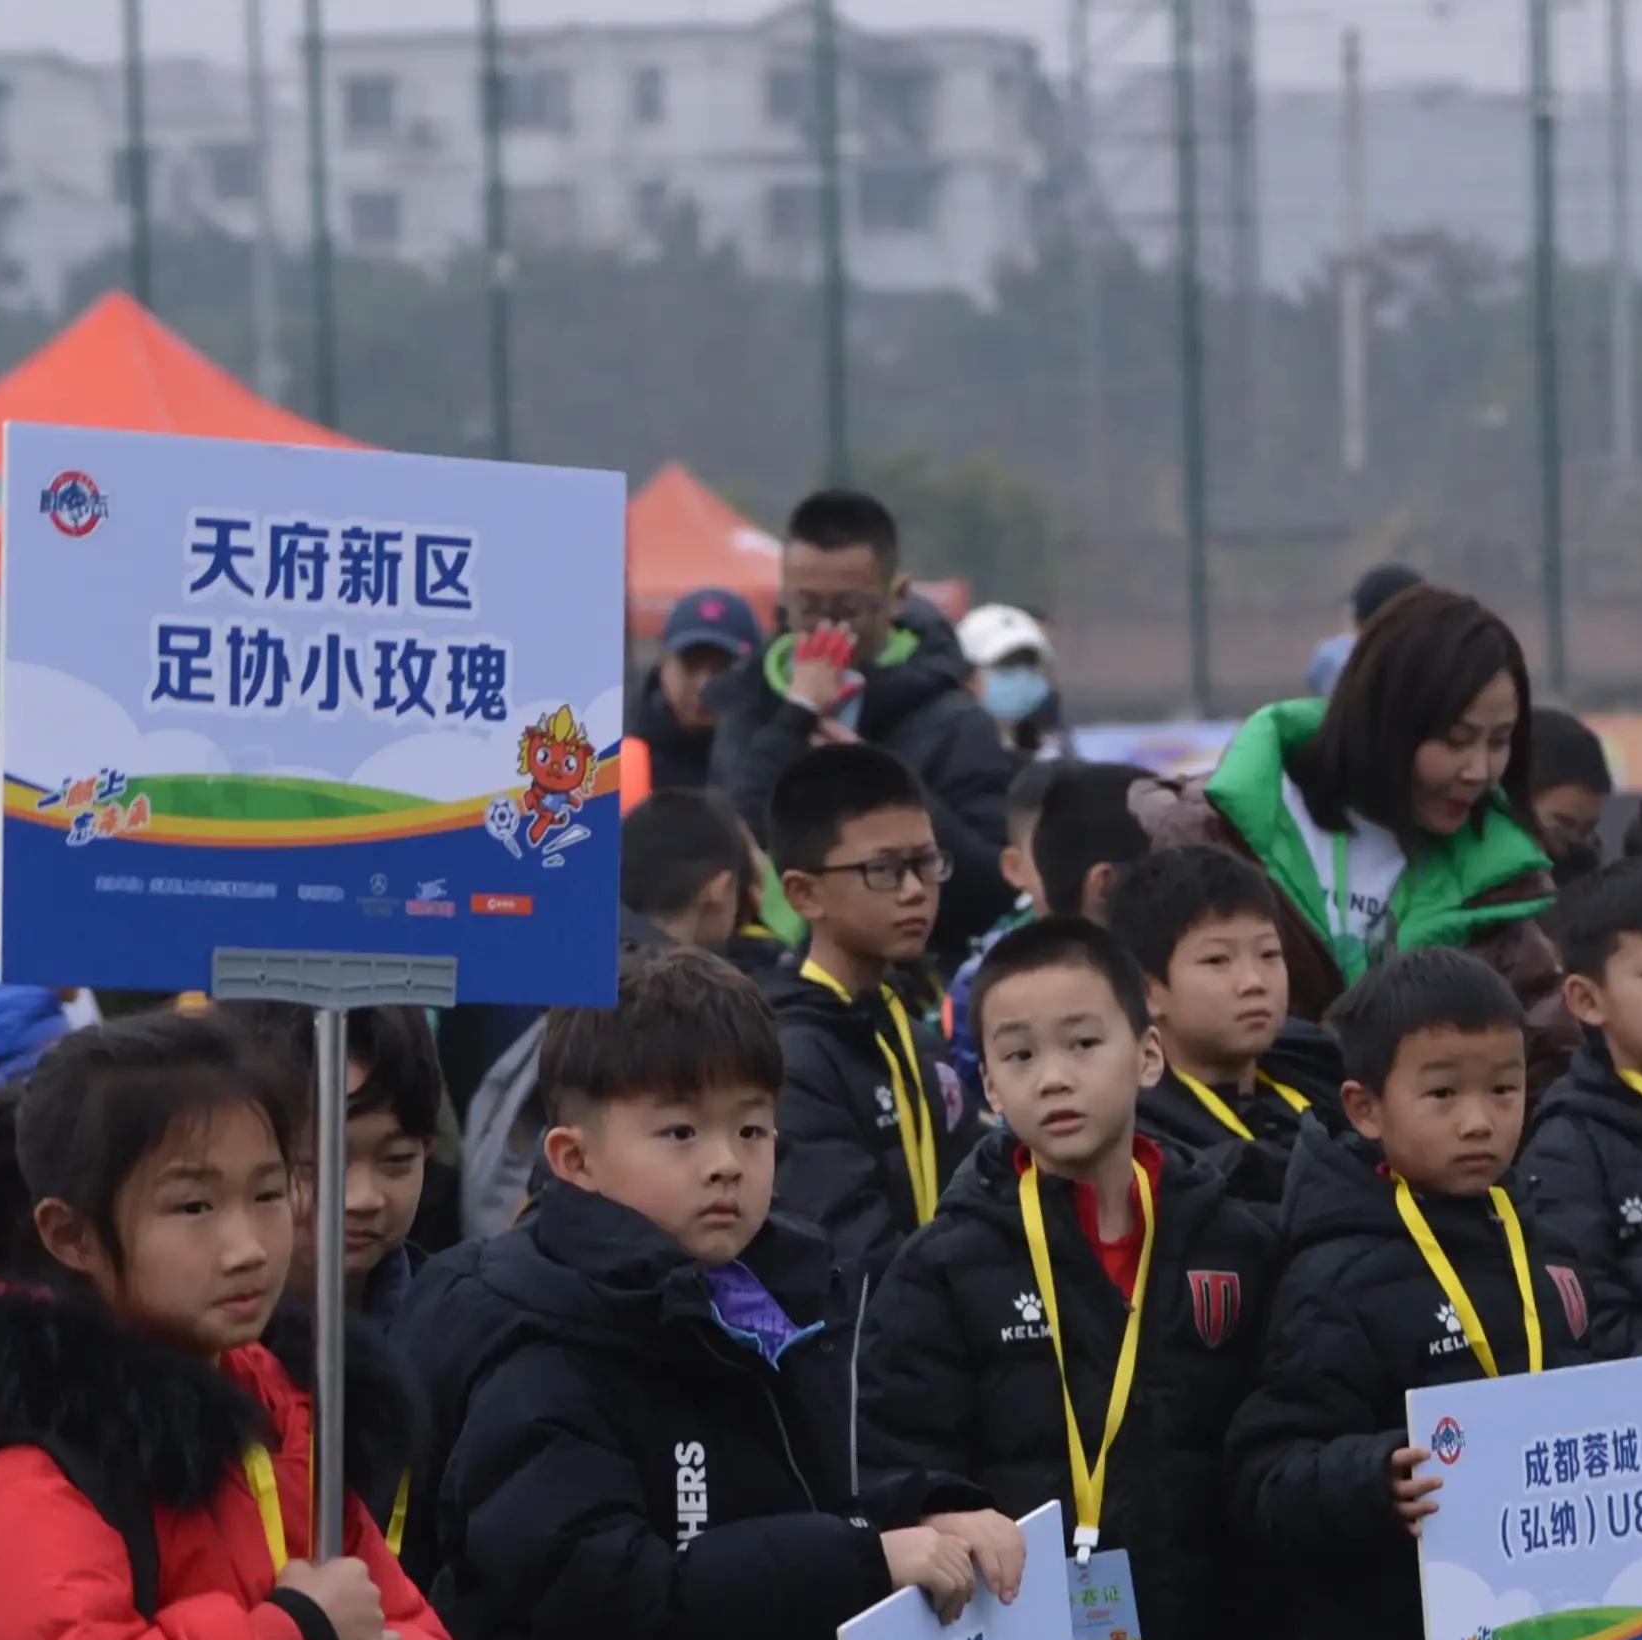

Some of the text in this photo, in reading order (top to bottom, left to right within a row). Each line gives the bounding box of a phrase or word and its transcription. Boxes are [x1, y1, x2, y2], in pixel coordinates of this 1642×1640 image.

[191, 516, 473, 610] 天府新区
[152, 624, 508, 721] 足协小玫瑰
[1001, 1324, 1055, 1342] KELM
[1524, 1428, 1641, 1489] 成都蓉城
[1070, 1585, 1120, 1607] 赛证
